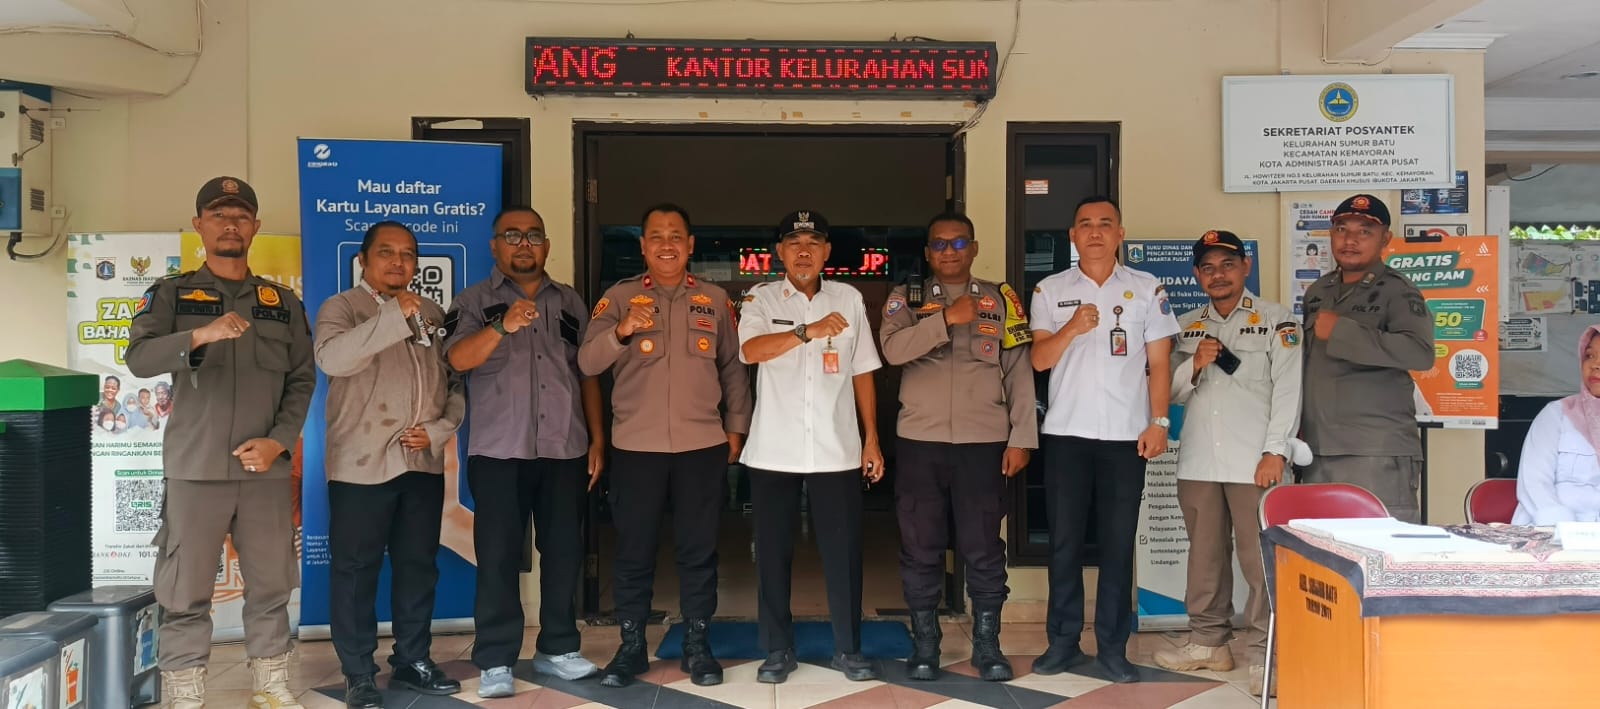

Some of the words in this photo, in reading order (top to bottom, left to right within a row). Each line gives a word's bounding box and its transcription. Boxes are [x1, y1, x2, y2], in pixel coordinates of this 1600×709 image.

[667, 56, 773, 78] KANTOR
[780, 58, 934, 79] KELURAHAN
[1263, 127, 1342, 137] SEKRETARIAT
[1345, 125, 1415, 136] POSYANTEK
[1283, 140, 1337, 148] KELURAHAN
[1339, 139, 1370, 147] SUMUR
[1372, 139, 1395, 147] BATU
[1283, 150, 1338, 158] KECAMATAN
[1340, 149, 1395, 157] KEMAYORAN
[1259, 160, 1283, 169] KOTA
[1285, 159, 1347, 168] ADMINISTRASI
[1349, 159, 1389, 167] JAKARTA
[1391, 158, 1419, 166] PUSAT
[357, 179, 391, 193] Mau
[395, 180, 442, 195] daftar
[316, 199, 360, 213] Kartu
[364, 200, 429, 217] Layanan
[433, 201, 486, 216] Gratis?
[442, 221, 458, 233] ini
[1389, 254, 1453, 269] GRATIS
[1434, 270, 1466, 281] PAM
[690, 305, 716, 316] POLRI
[1351, 304, 1367, 312] POL
[1368, 304, 1380, 312] PP
[1435, 311, 1462, 327] 50
[1240, 327, 1255, 335] POL
[1258, 327, 1268, 336] PP
